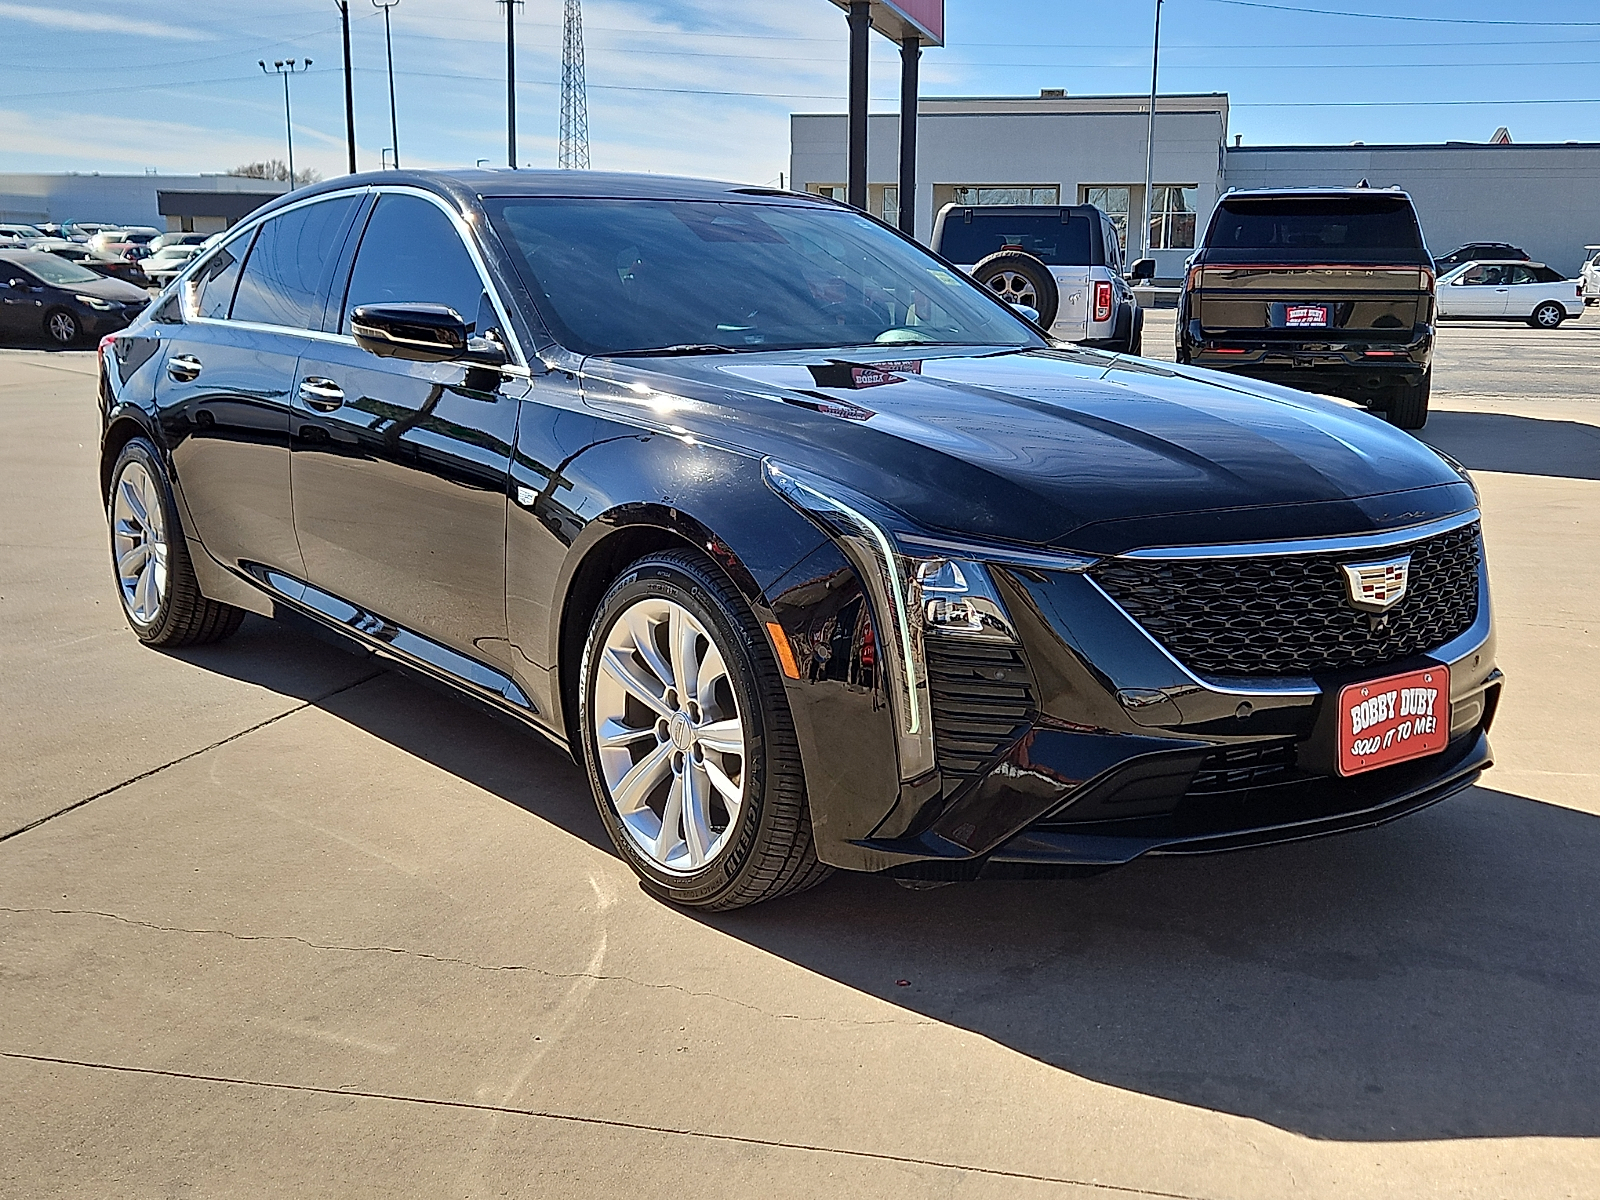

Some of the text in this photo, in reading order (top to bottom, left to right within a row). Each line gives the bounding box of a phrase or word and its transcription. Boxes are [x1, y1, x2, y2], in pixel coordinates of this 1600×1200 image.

[1350, 687, 1438, 735] BOBBY DUBY
[1350, 715, 1437, 756] SOLD IT TO ME!
[726, 777, 761, 875] MICHELIN
